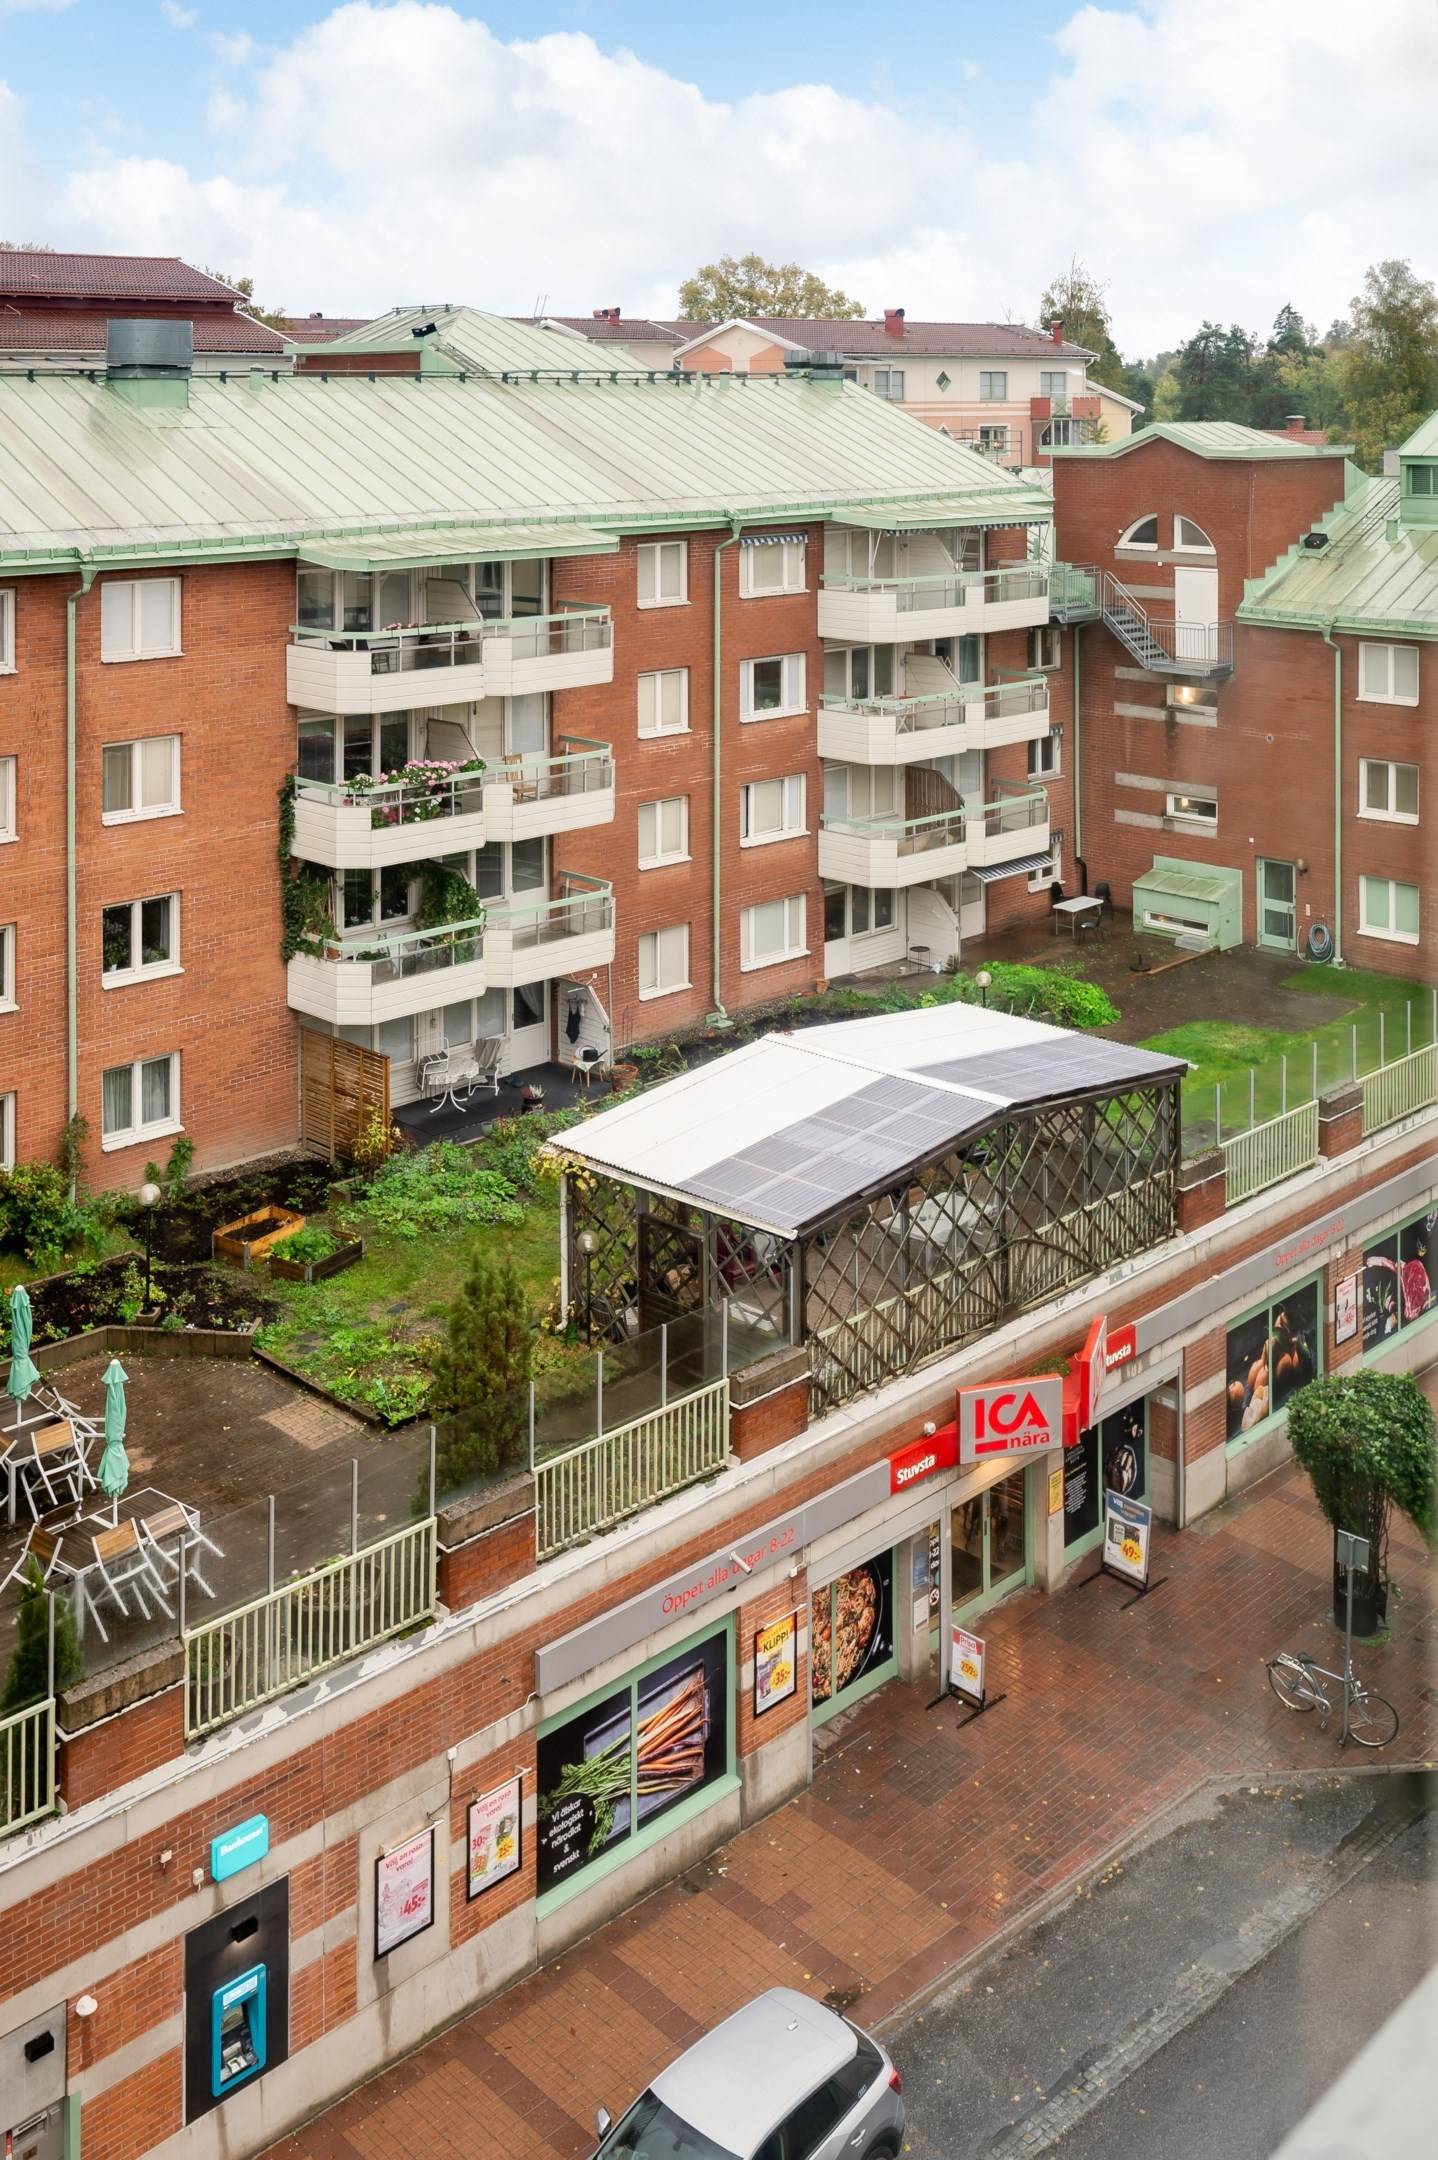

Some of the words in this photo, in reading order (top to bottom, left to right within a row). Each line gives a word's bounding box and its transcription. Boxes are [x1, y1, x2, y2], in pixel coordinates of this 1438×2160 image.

[1105, 1344, 1132, 1367] tuvsta
[974, 1391, 1050, 1440] ICA
[1010, 1431, 1050, 1449] nära
[896, 1453, 937, 1485] Stuvsta
[661, 1581, 704, 1616] Öppet
[707, 1567, 729, 1589] alla
[732, 1548, 765, 1574] dgar
[769, 1528, 796, 1553] 8-22
[763, 1630, 789, 1653] KLIPP!
[549, 1808, 584, 1837] ekologiskt
[552, 1811, 560, 1823] Vi
[560, 1799, 581, 1817] älskar
[553, 1849, 580, 1874] svenskt
